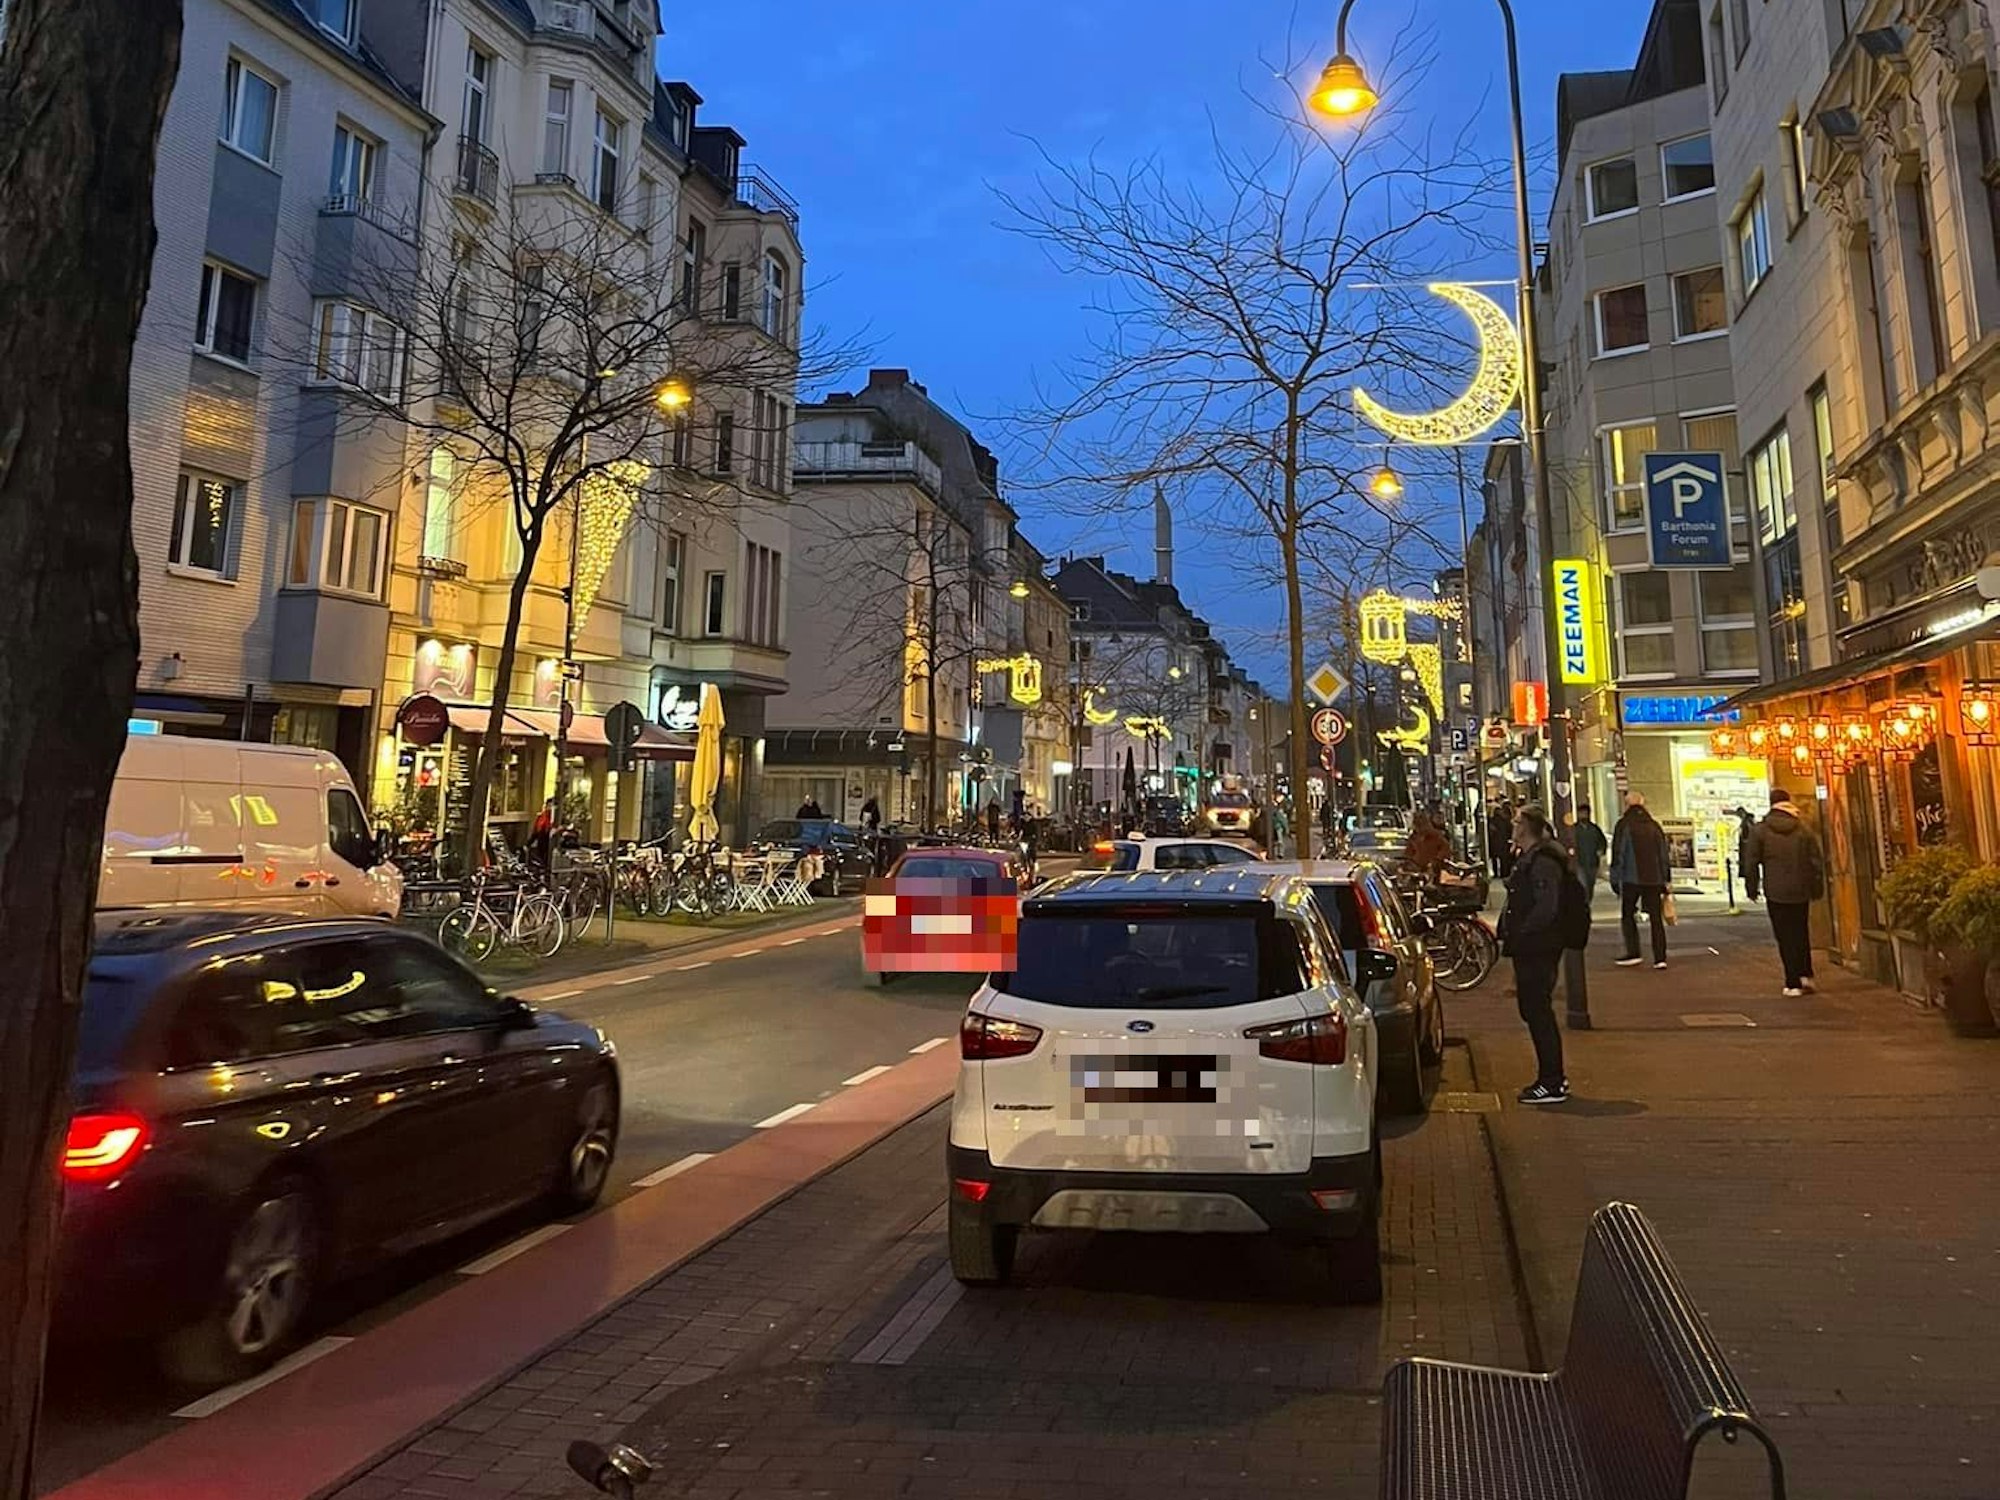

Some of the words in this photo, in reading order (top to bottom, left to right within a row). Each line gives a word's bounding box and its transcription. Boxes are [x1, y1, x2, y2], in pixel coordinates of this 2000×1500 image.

[1672, 478, 1703, 518] P
[1661, 520, 1716, 531] Barthonia
[1671, 534, 1708, 544] Forum
[1562, 569, 1585, 674] ZEEMAN
